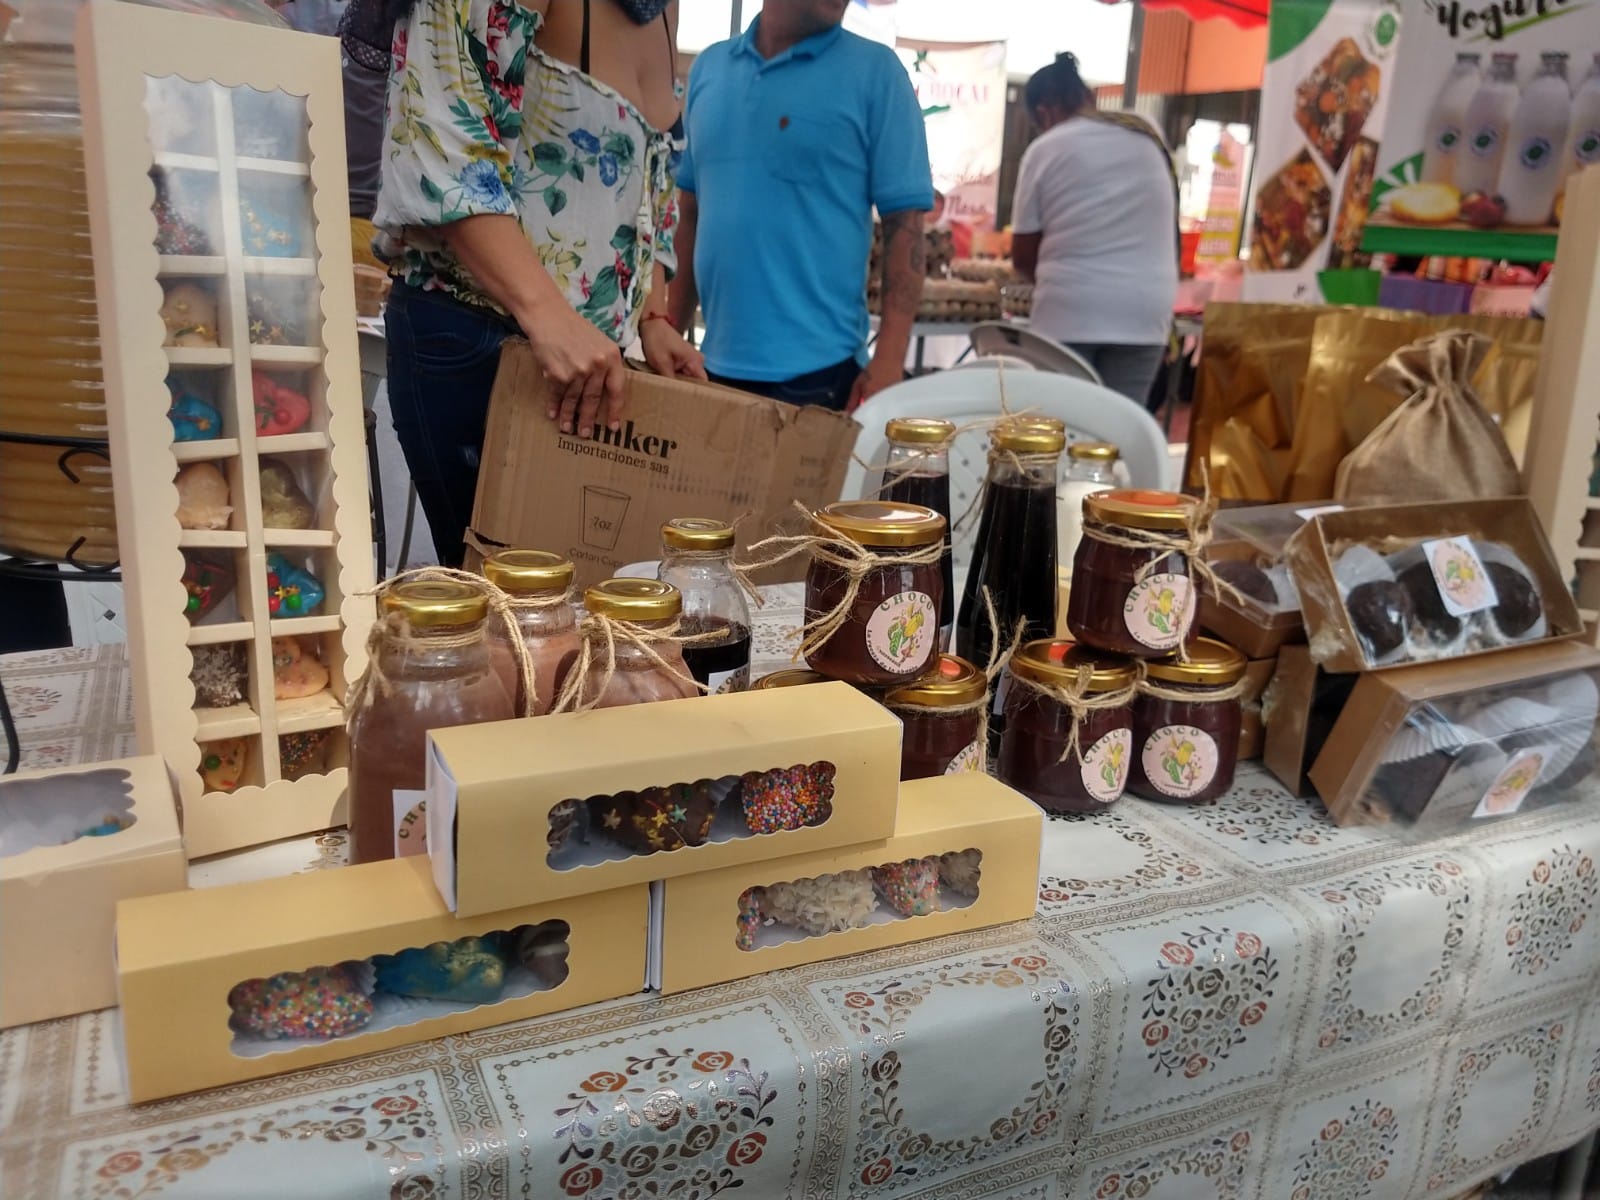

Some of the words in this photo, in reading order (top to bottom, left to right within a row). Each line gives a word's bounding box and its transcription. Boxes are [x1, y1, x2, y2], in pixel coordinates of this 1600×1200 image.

[558, 436, 647, 469] Importaciones
[649, 461, 670, 474] sas
[880, 592, 933, 611] CHOCO
[1125, 574, 1175, 612] CHOCO
[1084, 729, 1127, 763] CHOCO
[1145, 726, 1199, 751] CHOCO
[948, 743, 977, 771] HOC
